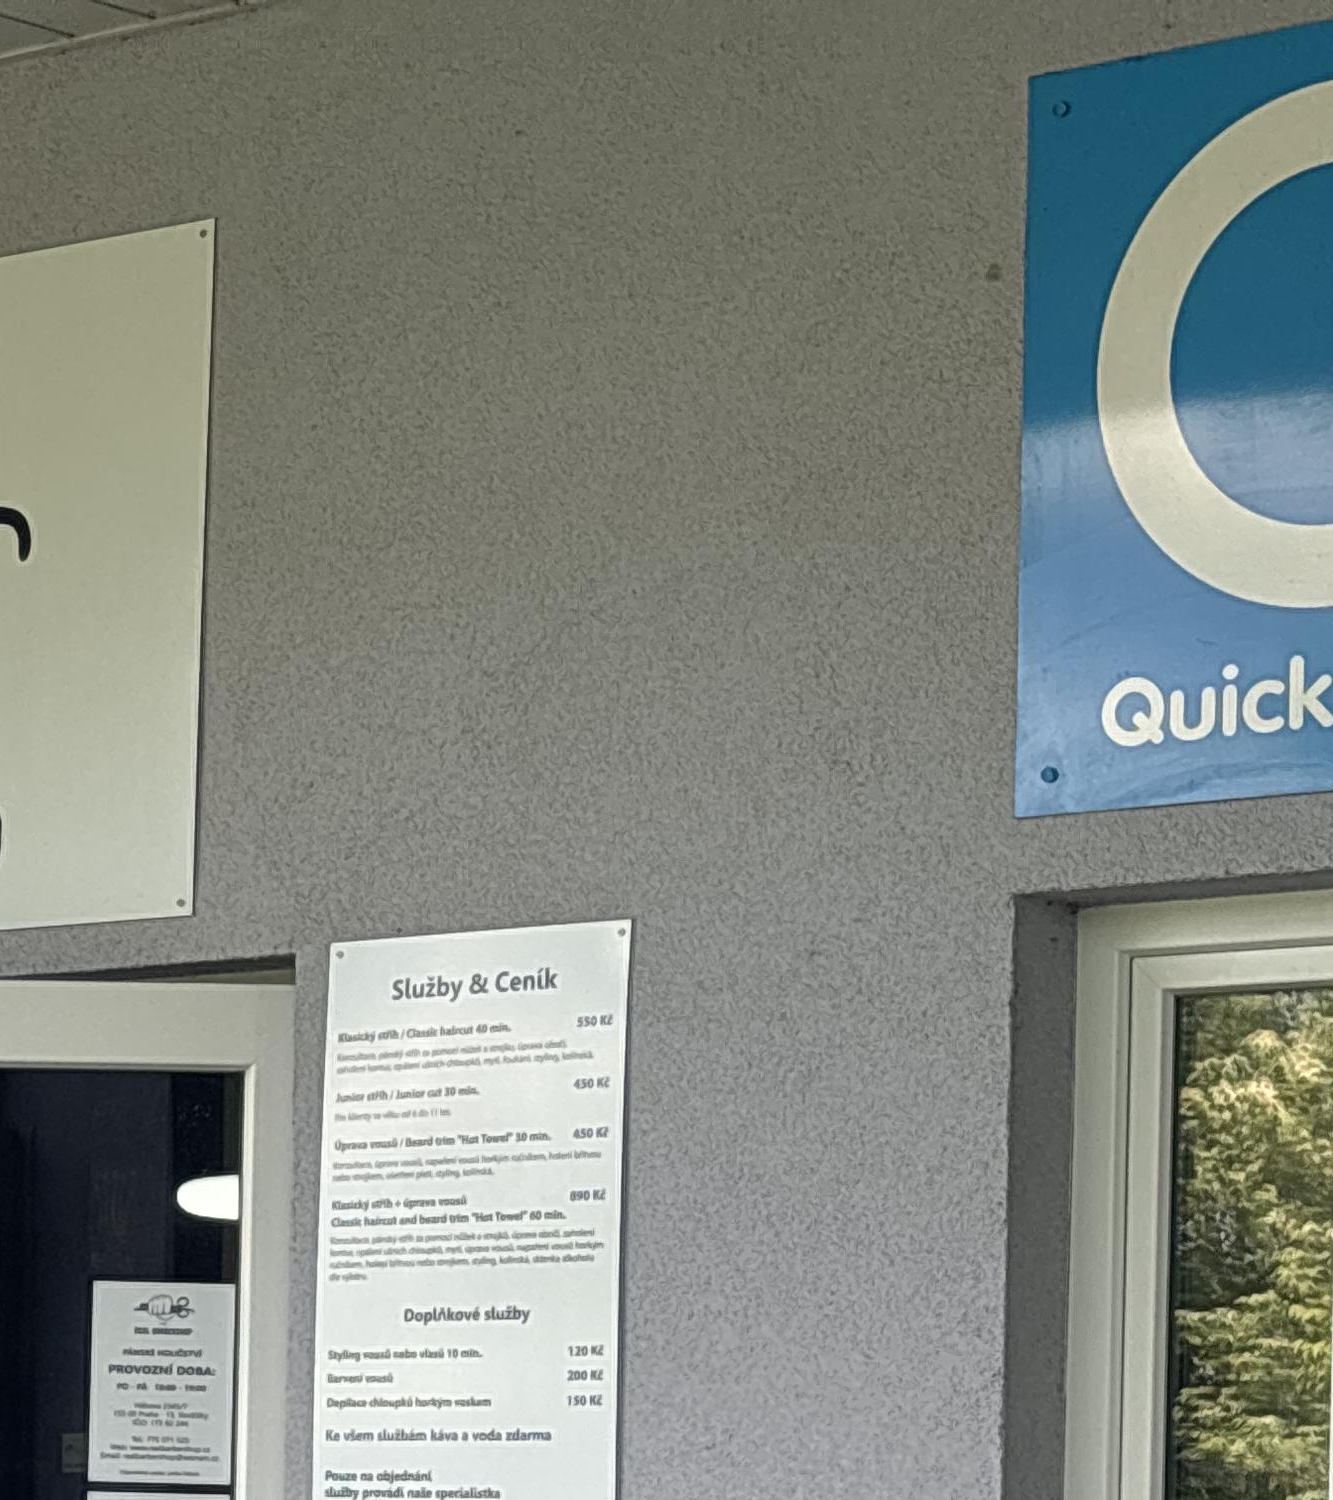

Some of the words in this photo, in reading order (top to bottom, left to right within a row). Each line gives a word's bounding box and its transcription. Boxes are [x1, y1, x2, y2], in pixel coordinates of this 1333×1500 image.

[391, 977, 462, 1002] Služby
[469, 974, 489, 994] &
[495, 967, 557, 993] Ceník
[439, 1024, 473, 1037] haircut
[399, 1214, 416, 1225] and
[404, 1308, 480, 1324] Doplňkové
[484, 1306, 530, 1323] služby
[567, 1345, 588, 1357] 120
[591, 1344, 604, 1356] Kč
[108, 1364, 172, 1376] PROVOZNÍ
[177, 1366, 216, 1376] DOBA:
[567, 1370, 587, 1381] 200
[590, 1369, 604, 1381] Kč
[567, 1395, 586, 1406] 150
[589, 1394, 603, 1406] Kč
[326, 1430, 340, 1441] Ke
[343, 1428, 374, 1442] všem
[430, 1429, 458, 1442] káva
[461, 1432, 469, 1442] a
[472, 1429, 503, 1442] voda
[505, 1429, 551, 1442] zdarma
[325, 1471, 357, 1482] Pouze
[360, 1474, 374, 1482] na
[407, 1487, 433, 1499] naše
[435, 1488, 500, 1500] specialistka
